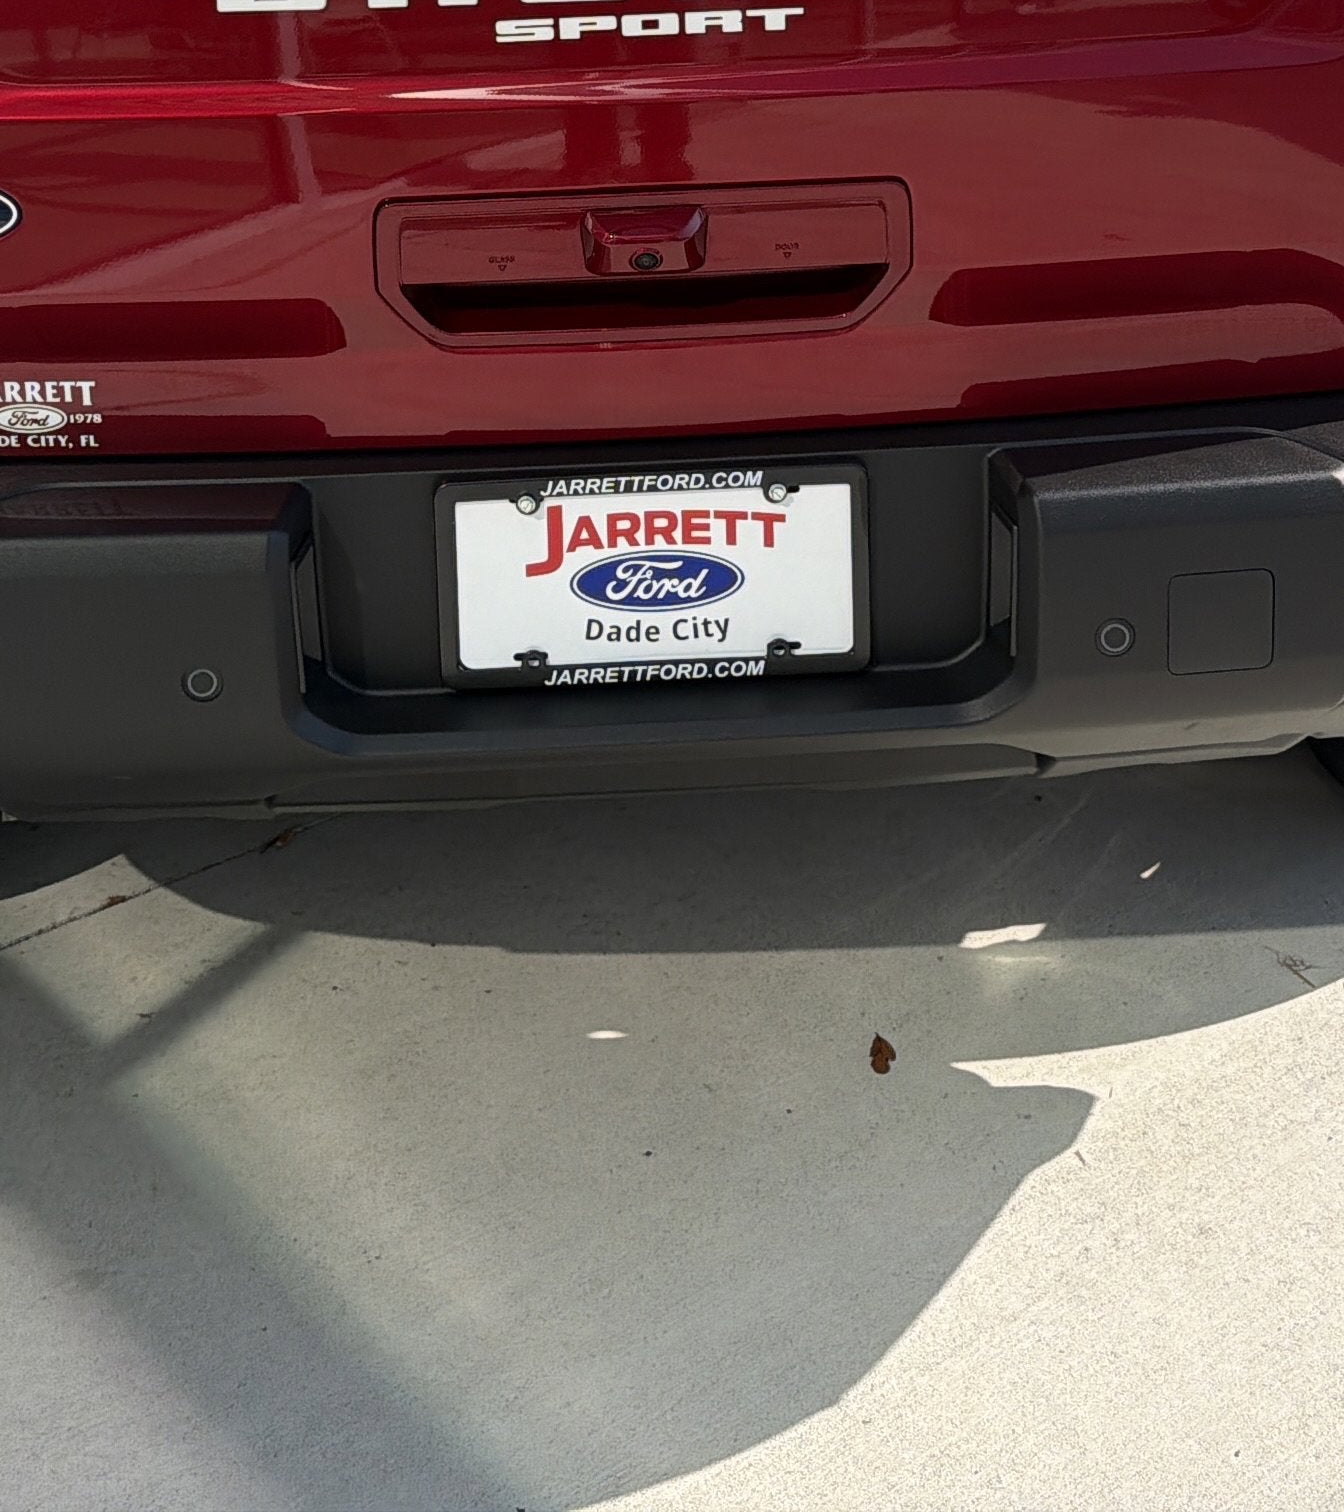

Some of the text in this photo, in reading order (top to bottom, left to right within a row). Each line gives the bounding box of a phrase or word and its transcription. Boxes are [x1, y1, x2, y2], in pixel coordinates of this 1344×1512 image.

[495, 7, 805, 43] SPORT
[7, 410, 50, 428] Ford
[69, 413, 102, 424] 1978
[27, 434, 74, 449] CITY,
[80, 434, 99, 447] FL
[540, 470, 764, 497] JARRETTFORD.COM
[525, 505, 786, 578] JARRETT
[605, 559, 709, 600] Ford
[585, 616, 731, 644] Dade City
[544, 659, 765, 686] JARRETTFORD.COM
